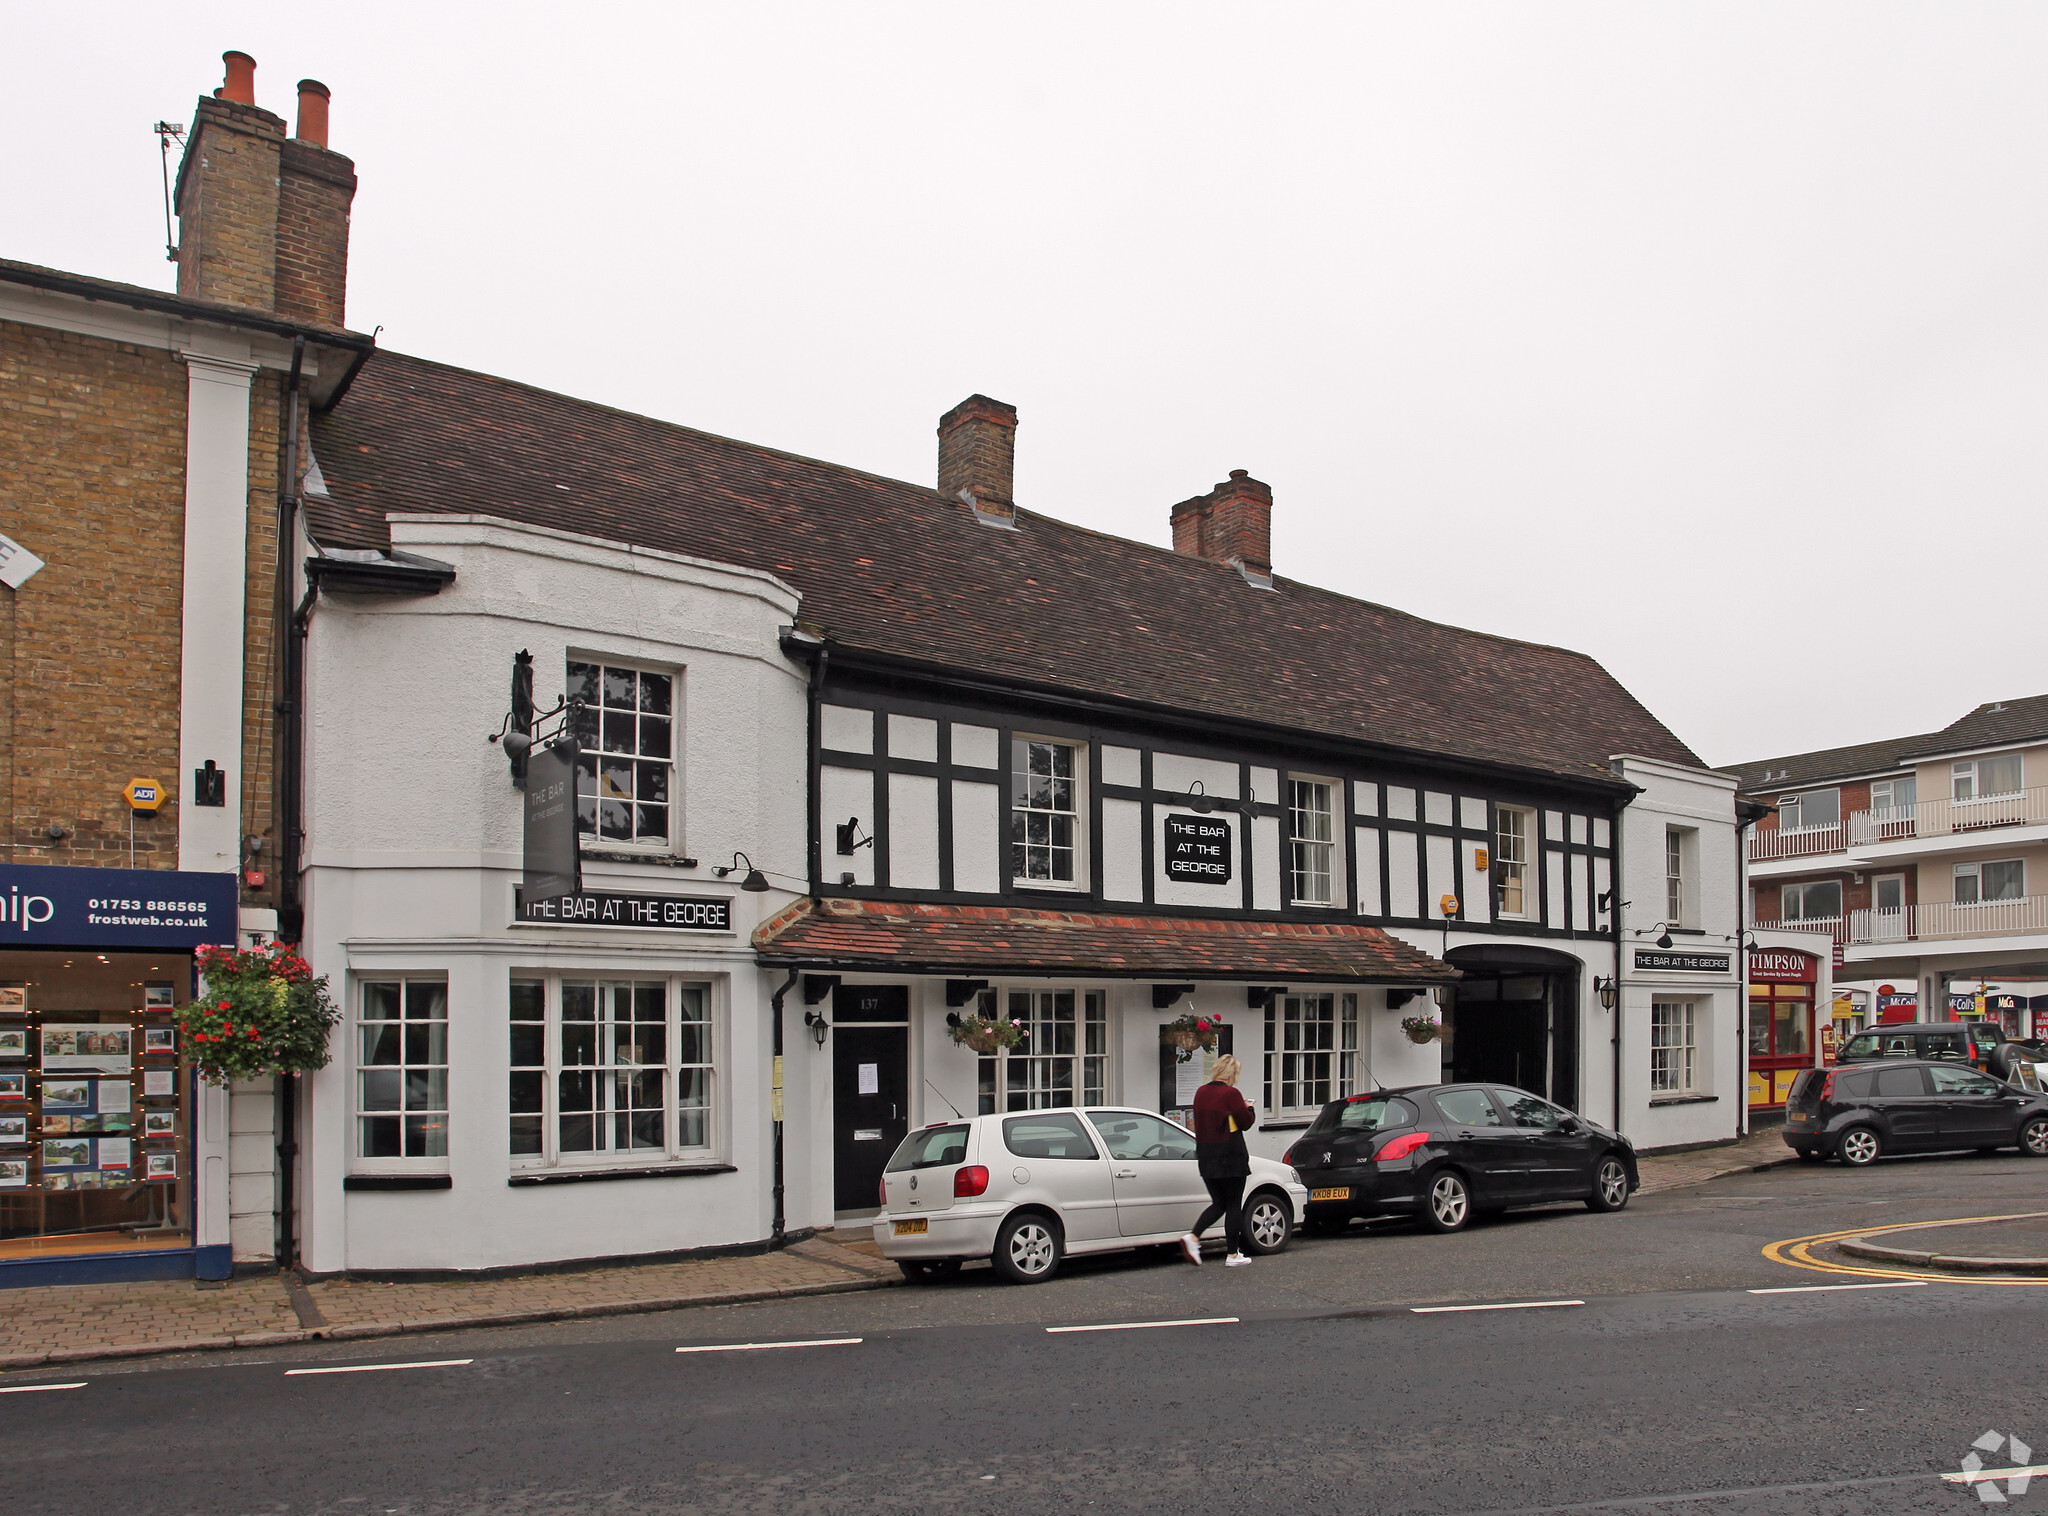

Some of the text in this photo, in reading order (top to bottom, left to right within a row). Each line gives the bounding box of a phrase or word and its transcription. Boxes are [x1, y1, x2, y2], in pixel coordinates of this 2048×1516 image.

[134, 789, 155, 799] ADT
[531, 781, 564, 806] THE BAR
[1170, 823, 1225, 838] THE BAR
[1177, 843, 1220, 856] AT THE
[1171, 860, 1225, 875] GEORGE
[88, 898, 207, 913] 01753 886565
[561, 896, 597, 919] BAR
[602, 899, 623, 921] AT
[627, 900, 659, 922] THE
[664, 902, 726, 925] GEORGE
[88, 913, 208, 928] frostweb.co.uk
[1635, 956, 1728, 968] THE BAR AT THE GEORGE
[1749, 953, 1805, 970] TIMPSON
[860, 998, 878, 1010] 137
[1312, 1188, 1348, 1199] KK08 EUX
